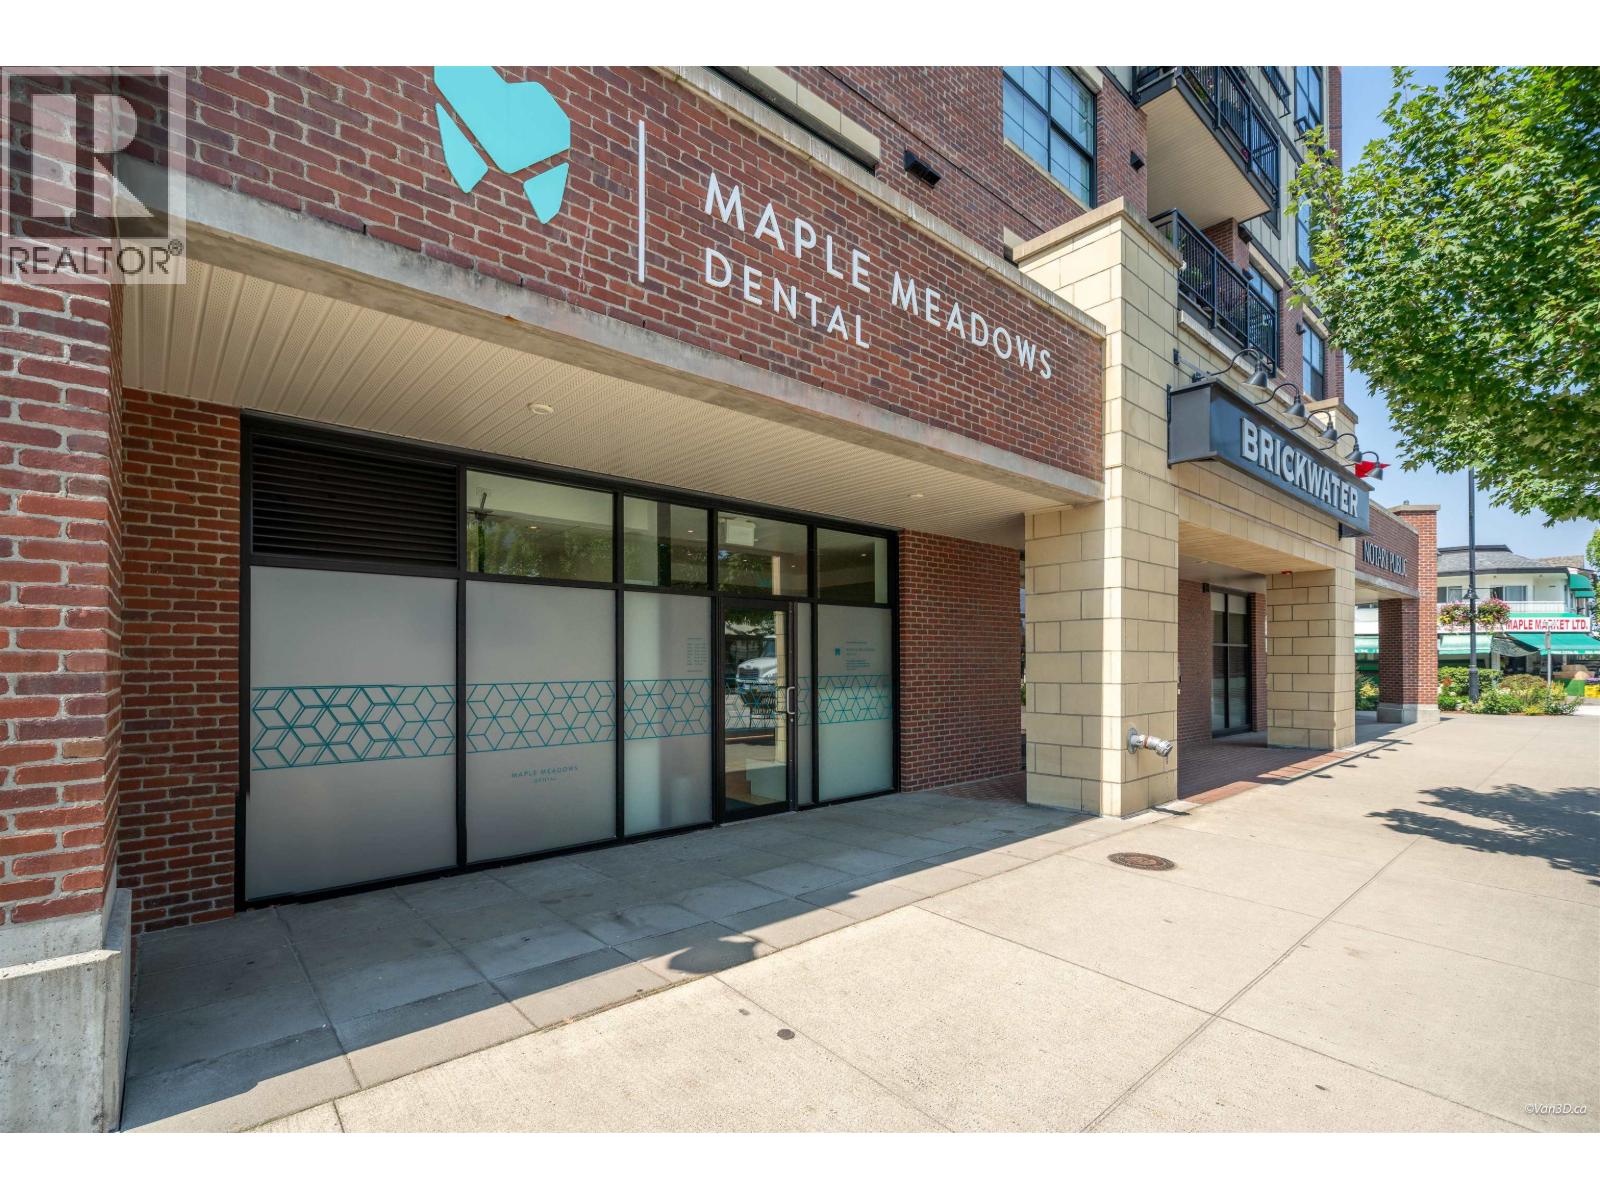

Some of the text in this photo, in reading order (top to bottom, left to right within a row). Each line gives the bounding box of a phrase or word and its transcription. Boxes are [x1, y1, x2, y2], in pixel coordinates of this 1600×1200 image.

[705, 171, 1053, 380] MAPLE MEADOWS
[705, 247, 870, 349] DENTAL
[1241, 417, 1359, 518] BRICKWATER
[1505, 618, 1533, 631] MAPLE
